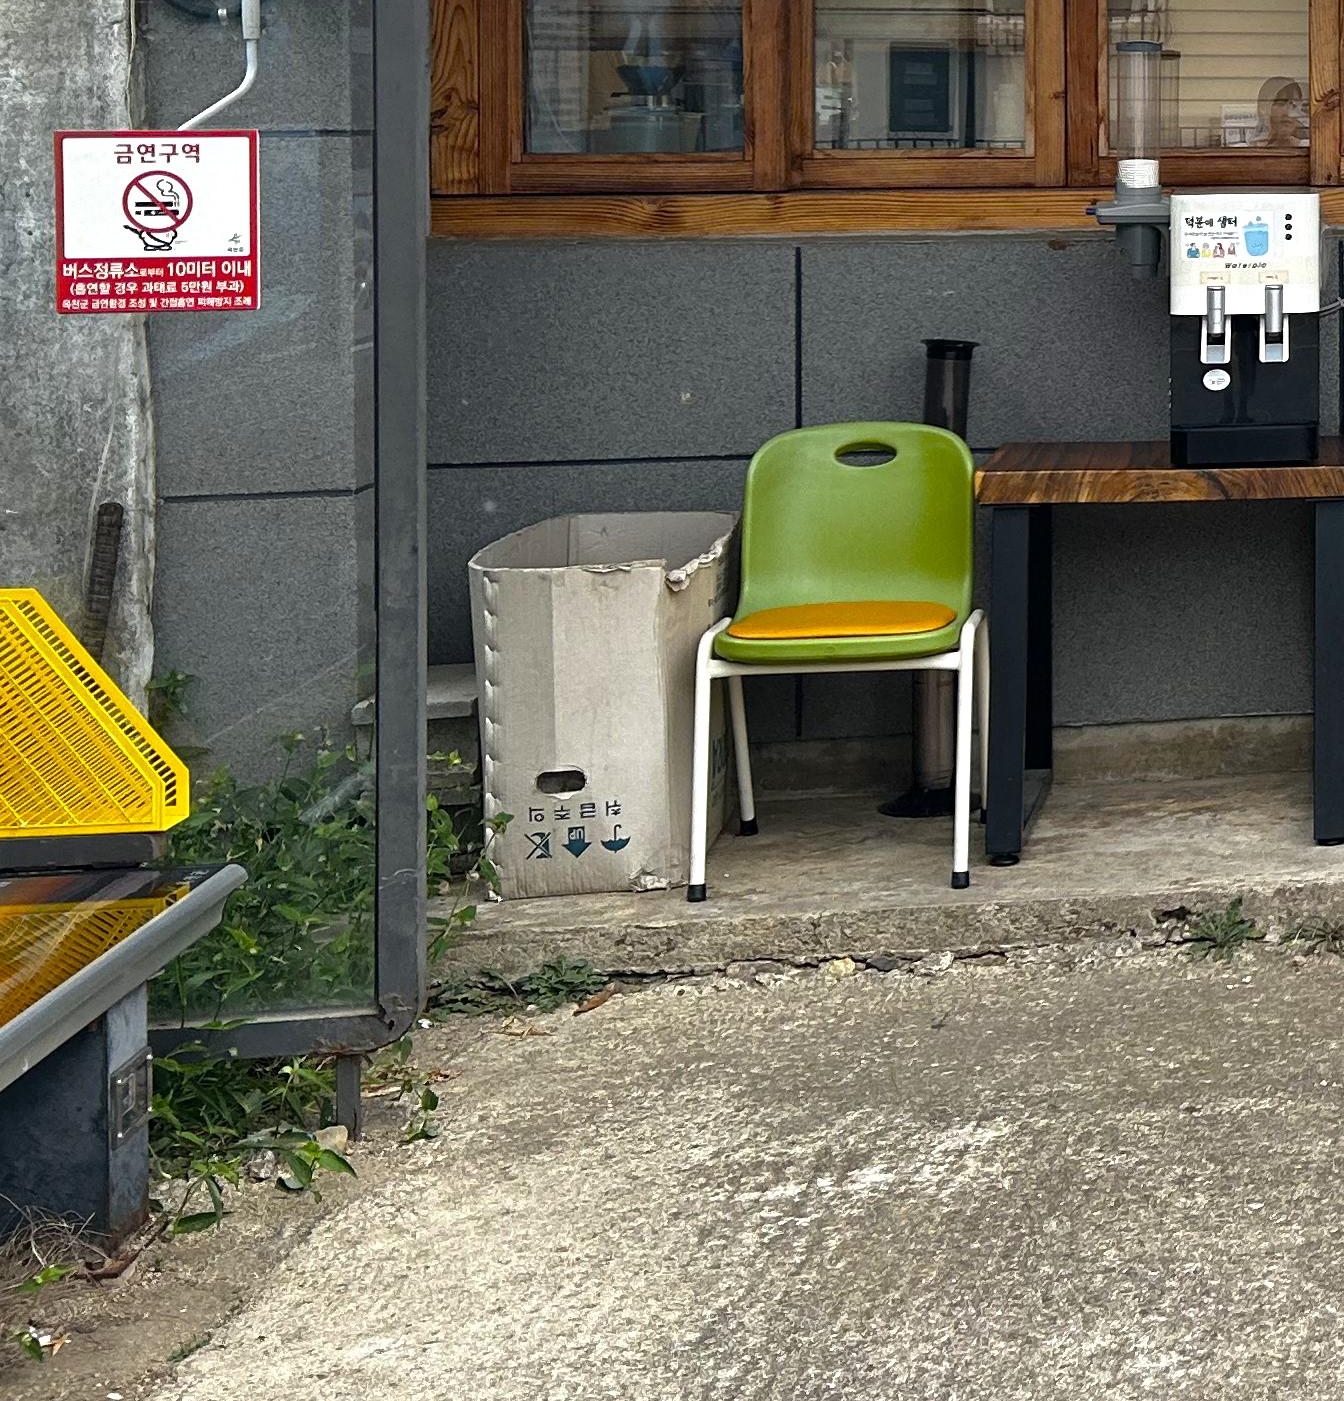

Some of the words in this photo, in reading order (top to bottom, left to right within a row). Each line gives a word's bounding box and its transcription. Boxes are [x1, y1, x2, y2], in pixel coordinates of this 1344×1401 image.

[113, 143, 202, 165] 금연구역
[62, 262, 164, 279] 버스정류소로부터
[167, 261, 216, 278] 10미터
[221, 260, 252, 278] 이내
[114, 282, 138, 295] 경우
[141, 281, 177, 294] 과태료
[181, 280, 212, 294] 5만원
[216, 279, 245, 293] 부과)
[528, 800, 622, 823] 취급주의
[569, 828, 584, 841] UP
